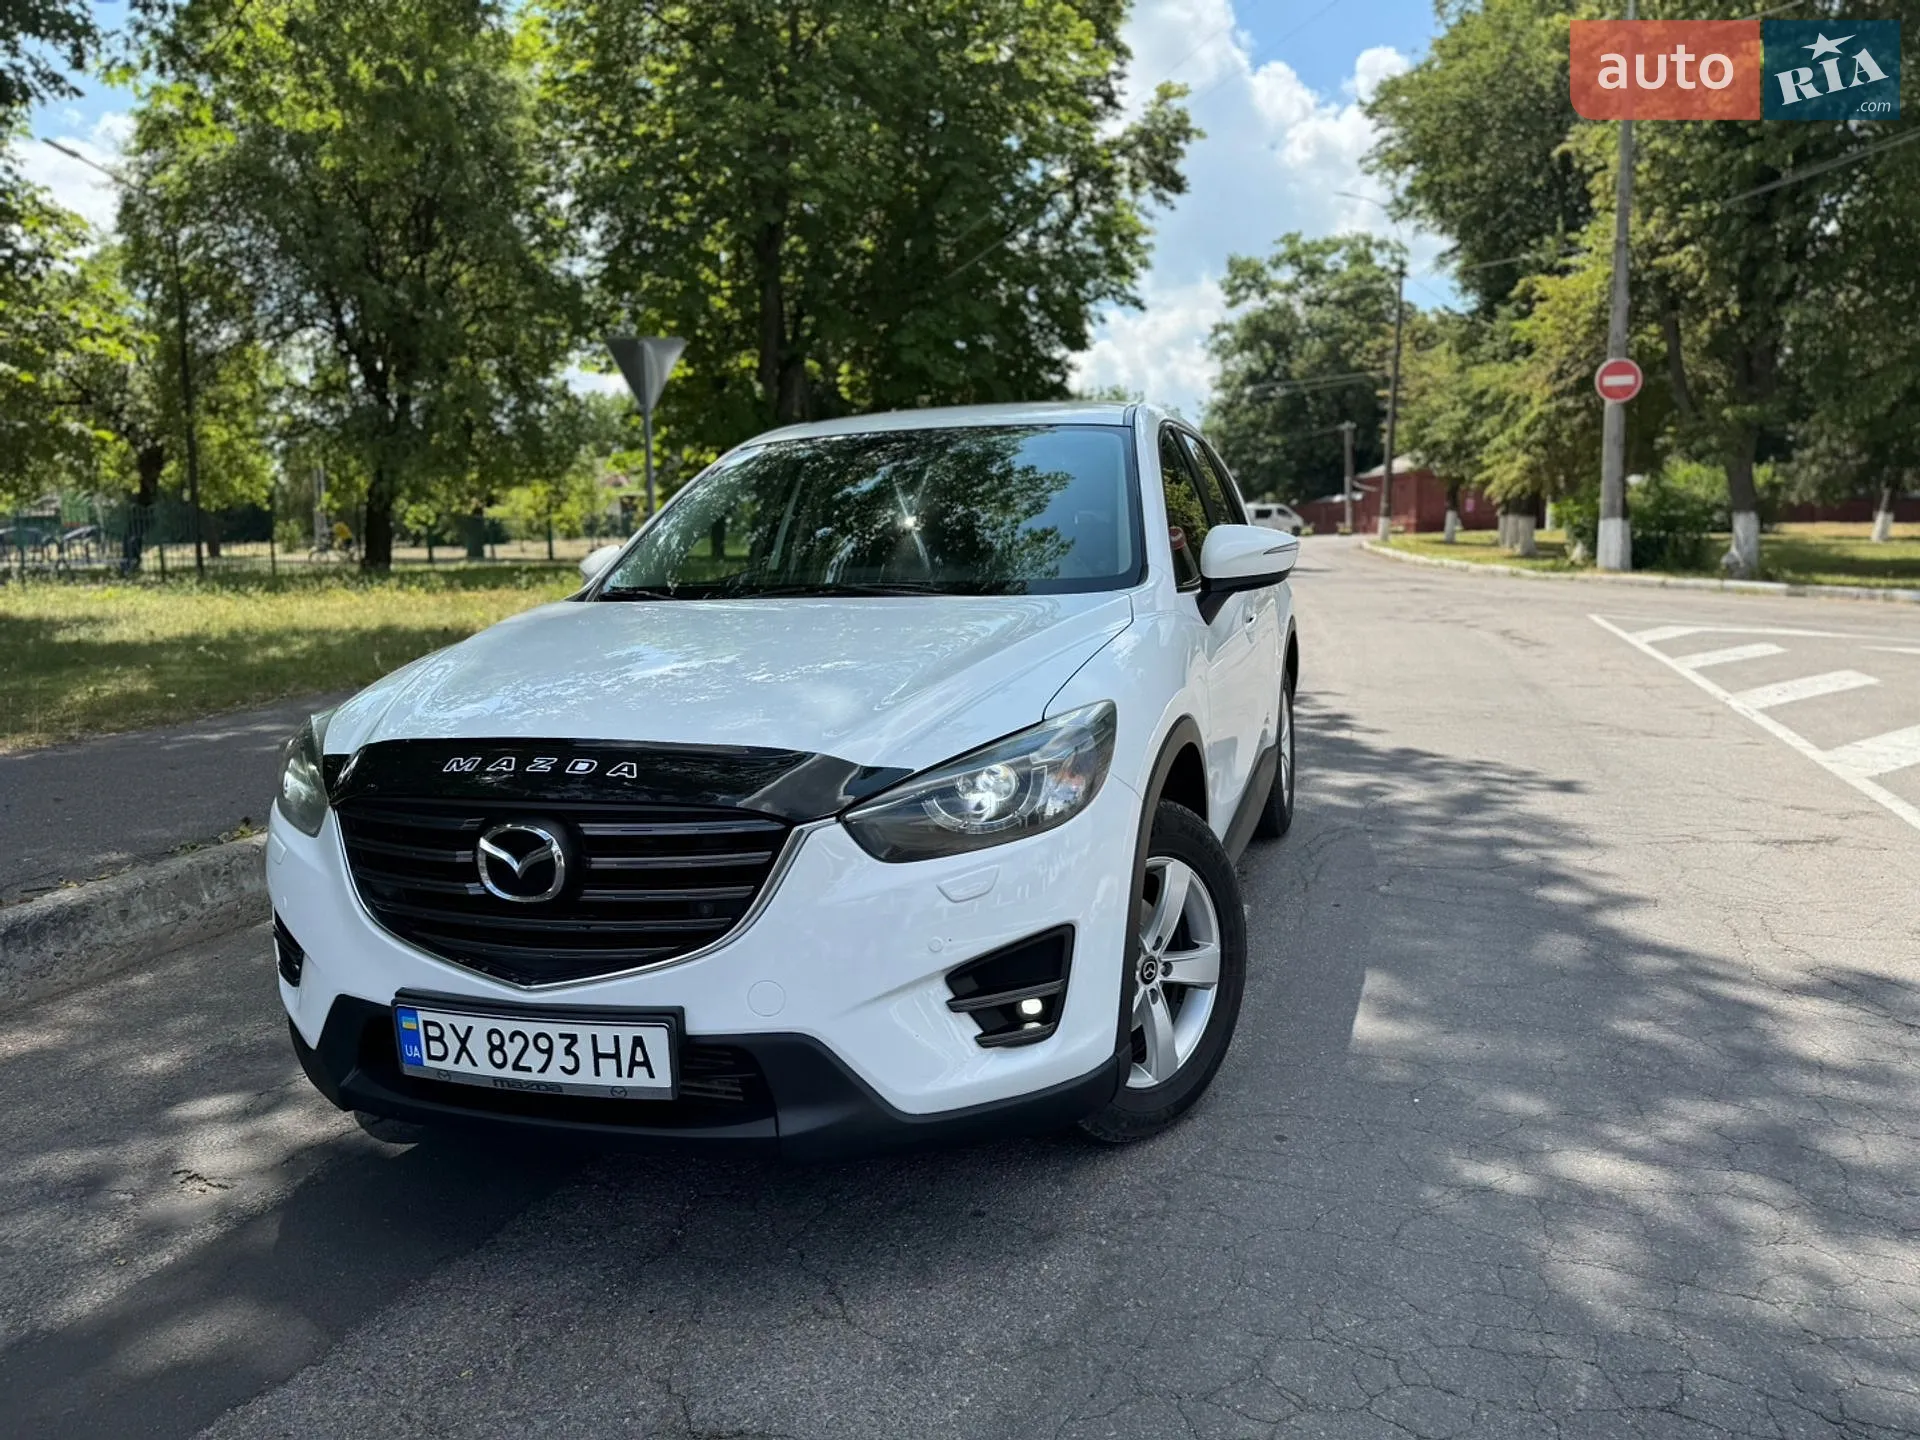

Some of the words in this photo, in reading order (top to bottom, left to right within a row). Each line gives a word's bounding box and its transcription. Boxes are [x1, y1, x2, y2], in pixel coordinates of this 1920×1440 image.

[443, 756, 637, 778] MAZDA
[405, 1043, 420, 1058] UA
[422, 1020, 478, 1067] BX
[486, 1028, 580, 1075] 8293
[591, 1034, 655, 1079] HA
